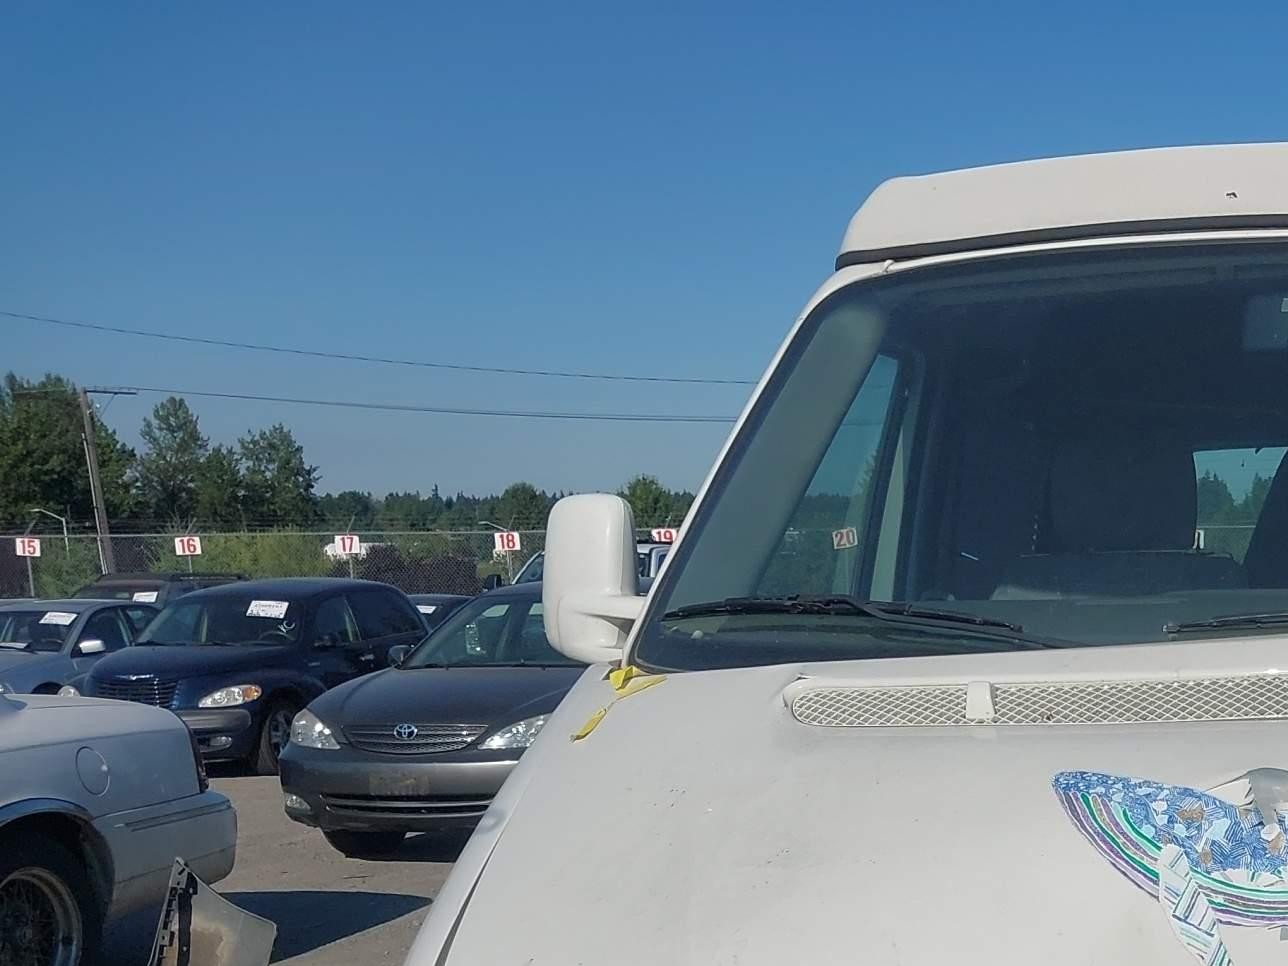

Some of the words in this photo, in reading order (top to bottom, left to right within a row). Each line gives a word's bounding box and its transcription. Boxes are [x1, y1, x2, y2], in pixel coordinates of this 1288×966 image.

[499, 534, 516, 549] 18
[656, 530, 673, 541] 19
[835, 530, 856, 547] 20
[20, 539, 36, 555] 15
[179, 538, 196, 553] 16
[340, 537, 354, 552] 17
